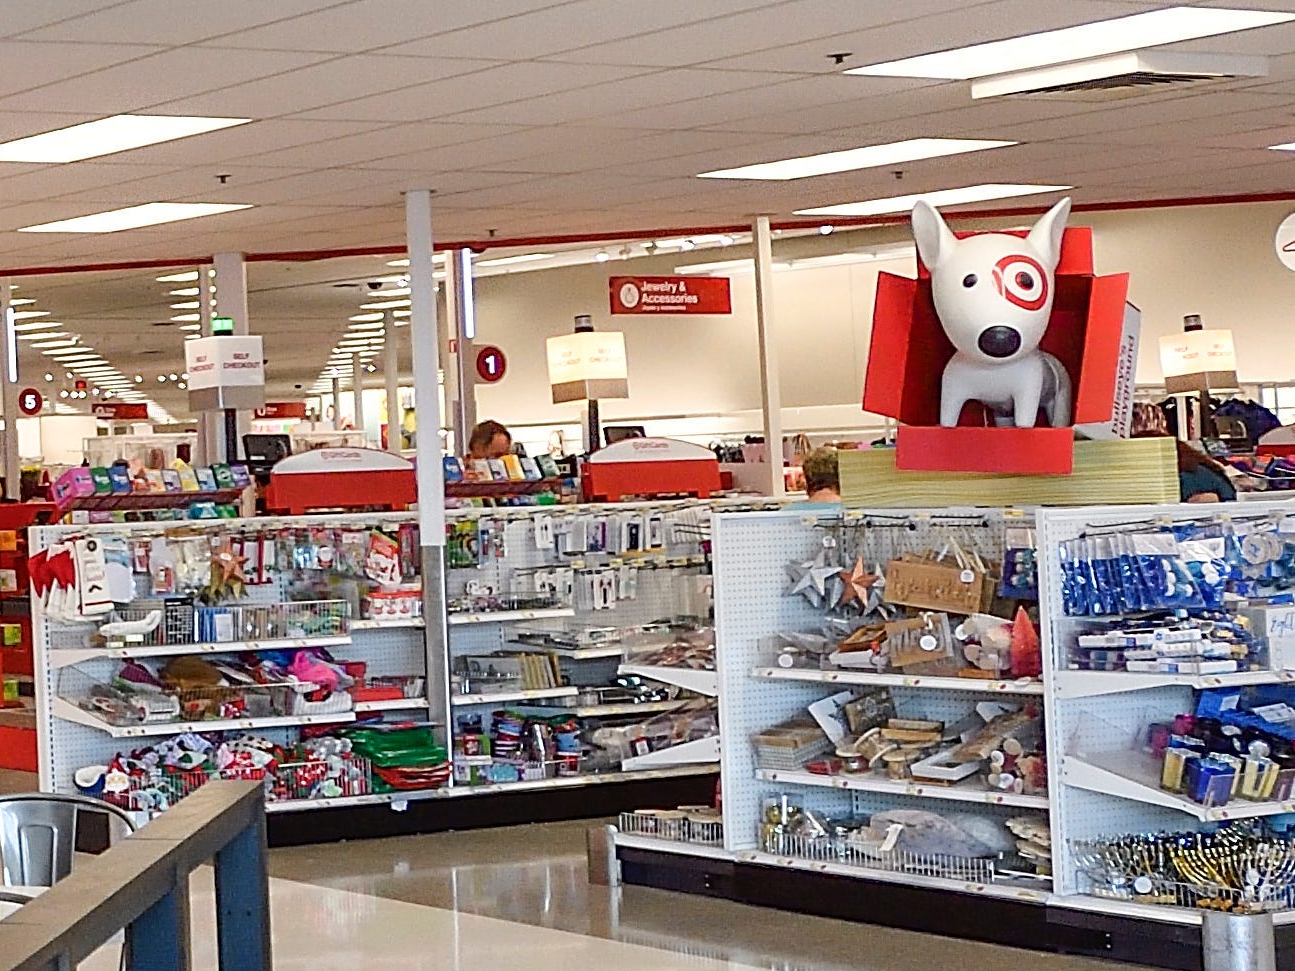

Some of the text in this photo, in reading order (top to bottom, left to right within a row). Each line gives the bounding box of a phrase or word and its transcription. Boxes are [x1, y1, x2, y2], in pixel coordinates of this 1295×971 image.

[641, 281, 686, 294] Jewelry &
[641, 293, 698, 304] Accessories
[484, 355, 496, 375] 1
[1111, 344, 1127, 435] bullseye's
[1118, 334, 1135, 439] playground
[24, 394, 37, 410] 5
